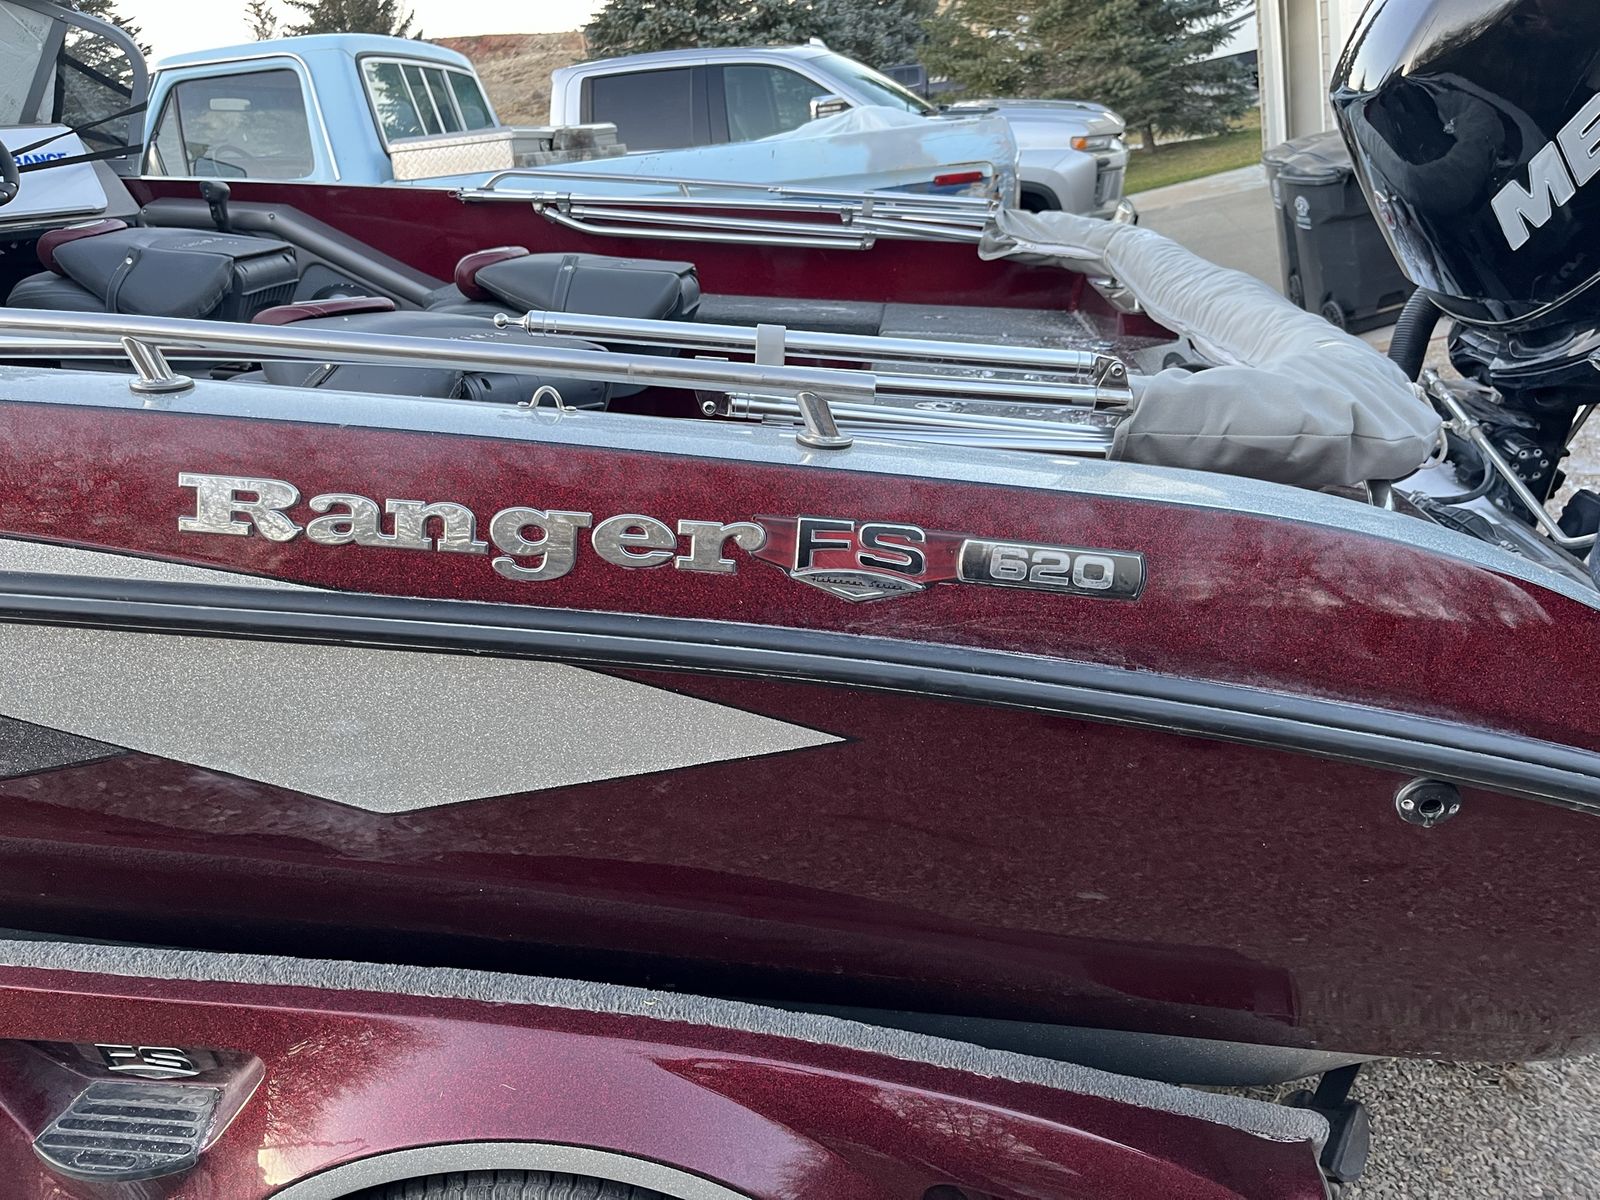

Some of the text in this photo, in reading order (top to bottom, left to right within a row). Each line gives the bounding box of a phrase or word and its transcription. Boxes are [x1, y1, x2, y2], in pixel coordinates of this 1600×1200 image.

[1491, 92, 1600, 251] ME
[178, 472, 1115, 590] Ranger FS 620
[94, 1043, 194, 1071] FS
